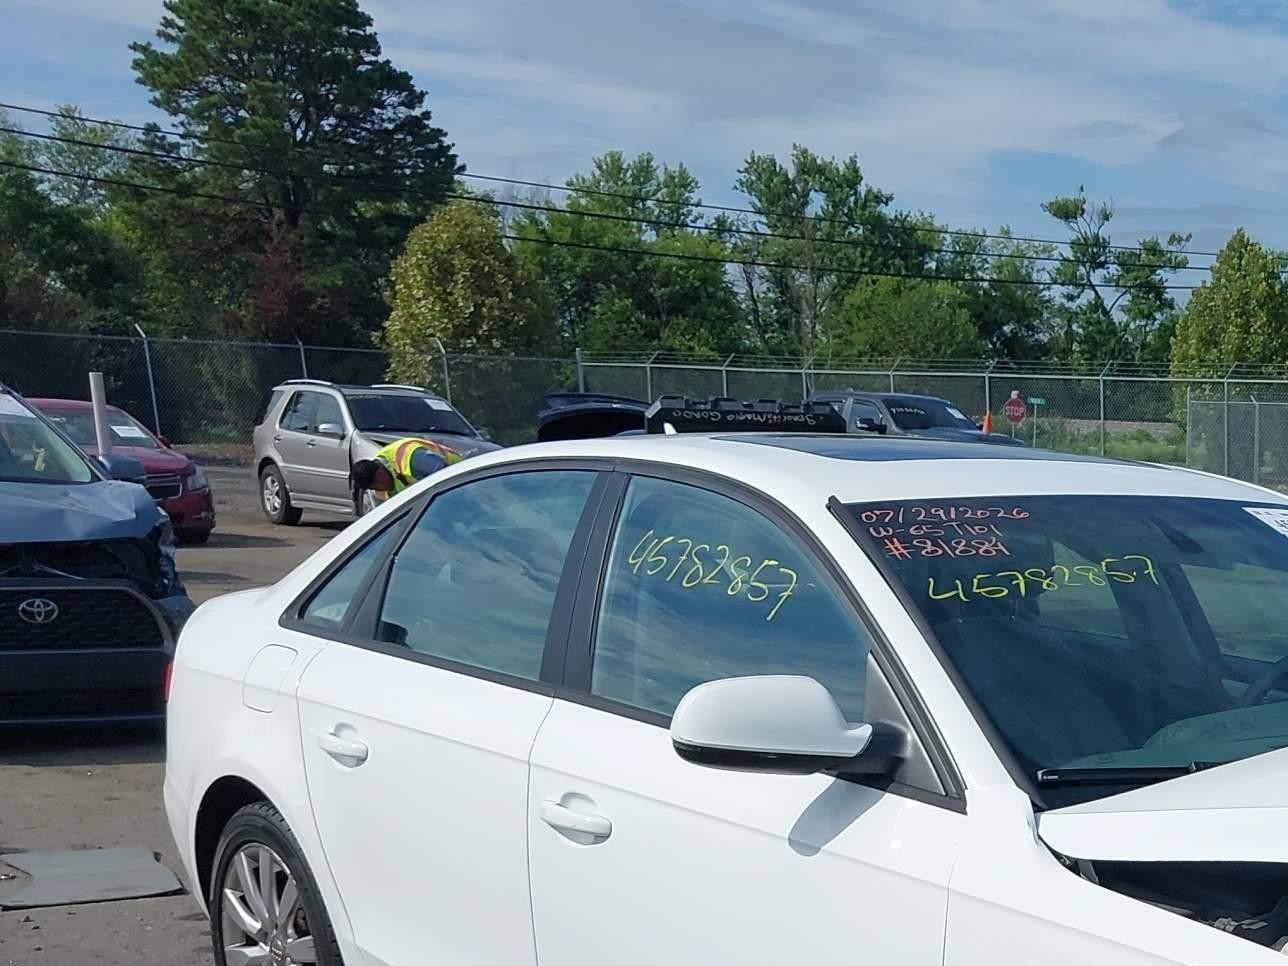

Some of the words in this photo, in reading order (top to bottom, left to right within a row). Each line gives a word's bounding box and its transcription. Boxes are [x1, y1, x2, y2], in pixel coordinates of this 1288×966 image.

[1005, 405, 1026, 417] STOP
[860, 506, 1030, 524] 07/29/2026
[628, 529, 798, 621] 45782857
[927, 555, 1160, 602] 45782857
